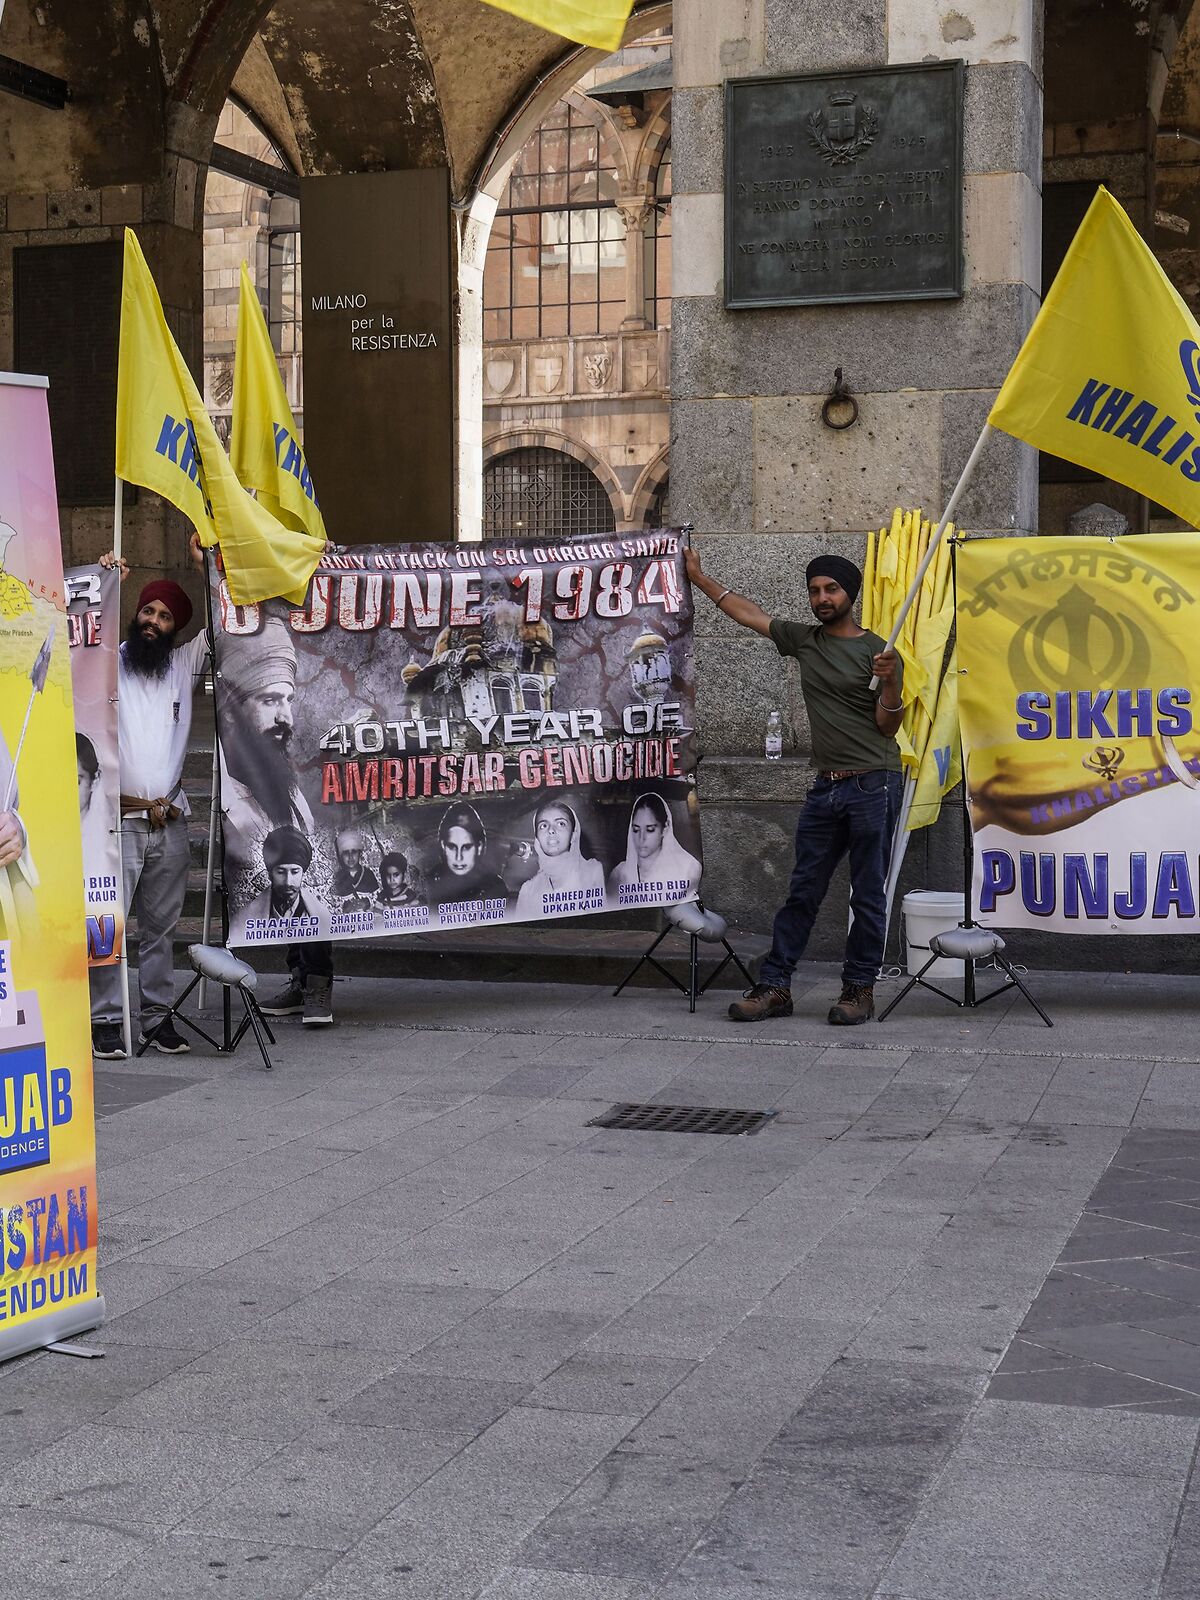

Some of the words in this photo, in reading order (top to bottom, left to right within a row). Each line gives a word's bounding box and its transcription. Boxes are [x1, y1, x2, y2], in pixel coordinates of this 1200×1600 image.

[753, 178, 812, 194] SUPREMO
[753, 199, 801, 215] HANNO
[809, 195, 865, 211] DONATO
[813, 215, 873, 232] MILANO
[738, 242, 755, 255] NE
[760, 238, 830, 254] CONSACRA
[789, 258, 830, 273] ALLA
[841, 255, 897, 271] STORIA
[312, 294, 367, 310] MILANO
[351, 318, 375, 333] per
[382, 314, 394, 328] la
[351, 333, 438, 351] RESISTENZA
[317, 554, 367, 570] RMY
[374, 551, 450, 570] ATTACK
[456, 549, 487, 568] ON
[492, 548, 529, 566] SRI
[533, 542, 613, 564] DARBAR
[621, 537, 679, 559] SAHIB
[28, 578, 65, 604] NEP
[289, 569, 482, 633] JUNE
[511, 558, 684, 624] 1984
[12, 629, 33, 638] Pradesh
[1015, 687, 1193, 741] SIKHS
[319, 719, 451, 756] 40TH
[465, 706, 604, 746] YEAR
[621, 702, 685, 735] OF
[320, 752, 508, 805] AMRITSAR
[518, 737, 685, 790] GENOCIDE
[90, 876, 116, 889] BIBI
[619, 881, 663, 895] SHAHEED
[666, 879, 690, 890] BIBI
[979, 850, 1200, 920] PUNJA
[88, 890, 117, 903] KAUR
[542, 890, 585, 904] SHAHEED
[586, 886, 604, 898] BIBI
[619, 892, 663, 905] PARAMJIT
[666, 889, 688, 901] KAUR
[384, 906, 429, 920] SHAHEED
[438, 899, 483, 915] SHAHEED
[485, 897, 507, 909] BIBI
[543, 902, 576, 914] UPKAR
[578, 898, 603, 911] KAUR
[246, 916, 320, 930] SHAHEED
[331, 911, 374, 925] SHAHEED
[415, 917, 430, 927] KAUR
[440, 912, 477, 925] PRITAM
[479, 909, 504, 921] KAUR
[245, 929, 284, 941] MOHAR
[286, 927, 319, 939] SINGH
[358, 922, 374, 932] KAUR
